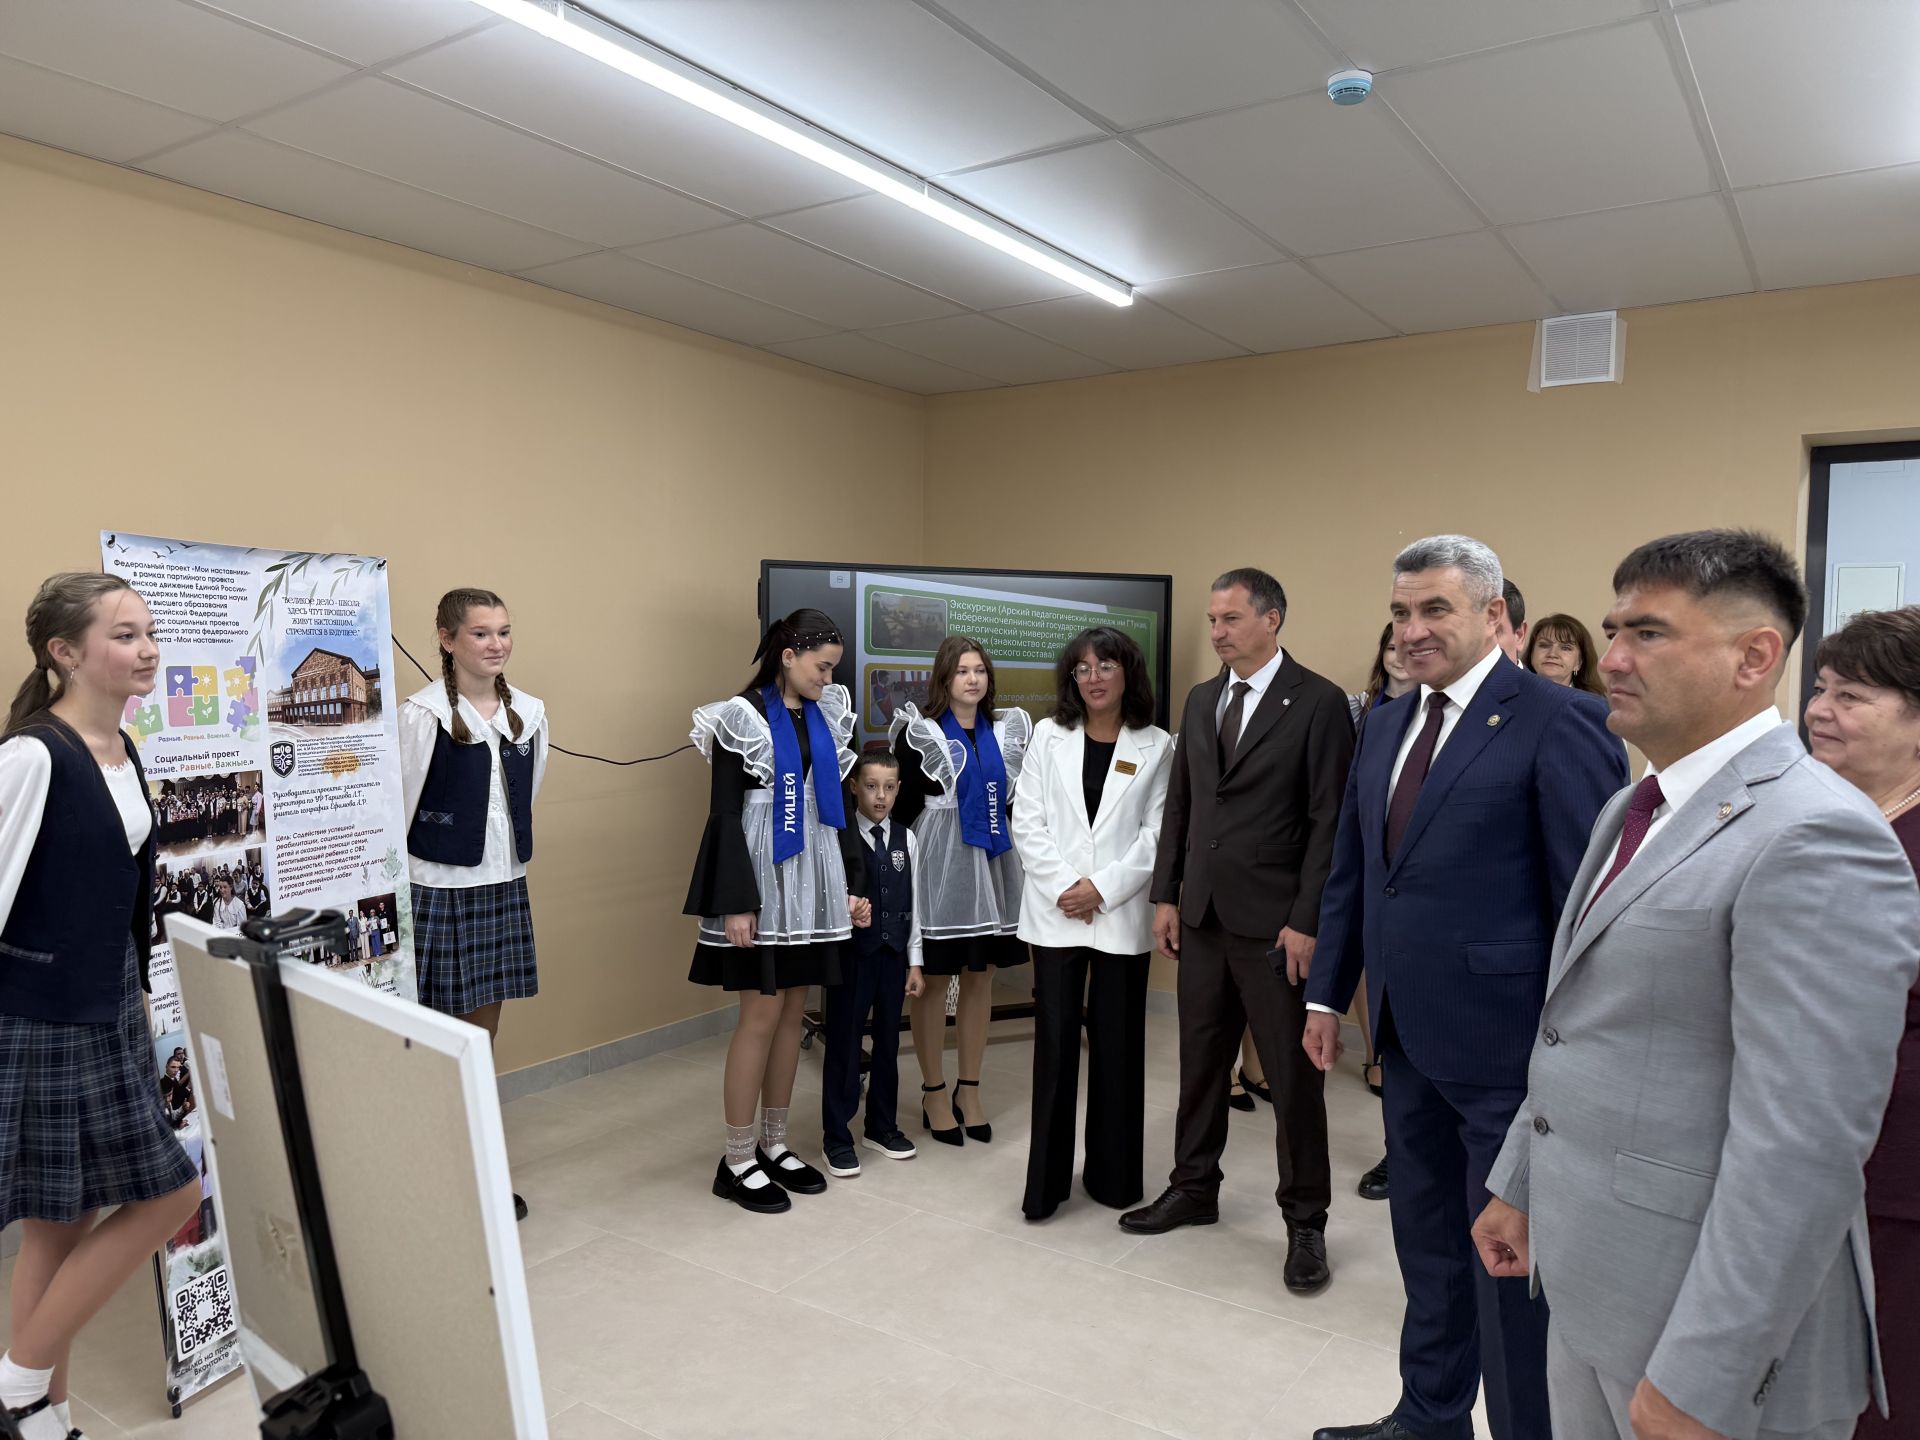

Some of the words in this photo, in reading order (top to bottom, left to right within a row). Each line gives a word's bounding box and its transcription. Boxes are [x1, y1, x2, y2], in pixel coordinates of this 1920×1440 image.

[113, 559, 164, 570] Федеральный
[166, 564, 190, 573] проект
[138, 572, 166, 581] рамках
[167, 574, 206, 582] партийного
[208, 576, 235, 585] проекта
[159, 582, 194, 591] движение
[195, 583, 220, 592] Единой
[179, 592, 228, 601] Министерства
[184, 600, 228, 609] образования
[950, 600, 997, 613] Экскурсии
[998, 604, 1030, 617] (Арский
[1031, 610, 1088, 622] педагогический
[149, 608, 188, 616] оссийской
[188, 609, 228, 618] Федерации
[167, 618, 208, 627] социальных
[209, 620, 240, 628] проектов
[949, 610, 1045, 628] Набережночелнинский
[1046, 622, 1088, 632] государств
[202, 628, 249, 638] федерального
[949, 623, 1018, 636] педагогический
[1020, 628, 1068, 641] университет,
[990, 636, 1040, 649] (знакомство
[1022, 650, 1055, 660] состава)
[154, 750, 210, 764] Социальный
[212, 750, 240, 760] проект
[180, 763, 214, 772] Равные.
[784, 771, 798, 834] ЛИЦЕЙ
[988, 780, 999, 835] ЛИЦЕЙ
[292, 828, 327, 839] Содействие
[328, 824, 355, 835] успешной
[320, 832, 353, 843] социальной
[354, 827, 384, 838] адаптации
[276, 850, 294, 859] детей
[300, 844, 327, 855] оказание
[327, 840, 350, 850] помощи
[277, 853, 324, 867] воспитывающей
[324, 854, 361, 866] посредством
[278, 871, 314, 884] проведения
[337, 862, 360, 872] классов
[284, 881, 305, 892] уроков
[306, 876, 334, 885] семейной
[153, 967, 173, 977] оставл
[174, 1358, 204, 1378] Ссылка
[204, 1353, 214, 1362] на
[214, 1338, 238, 1355] профи
